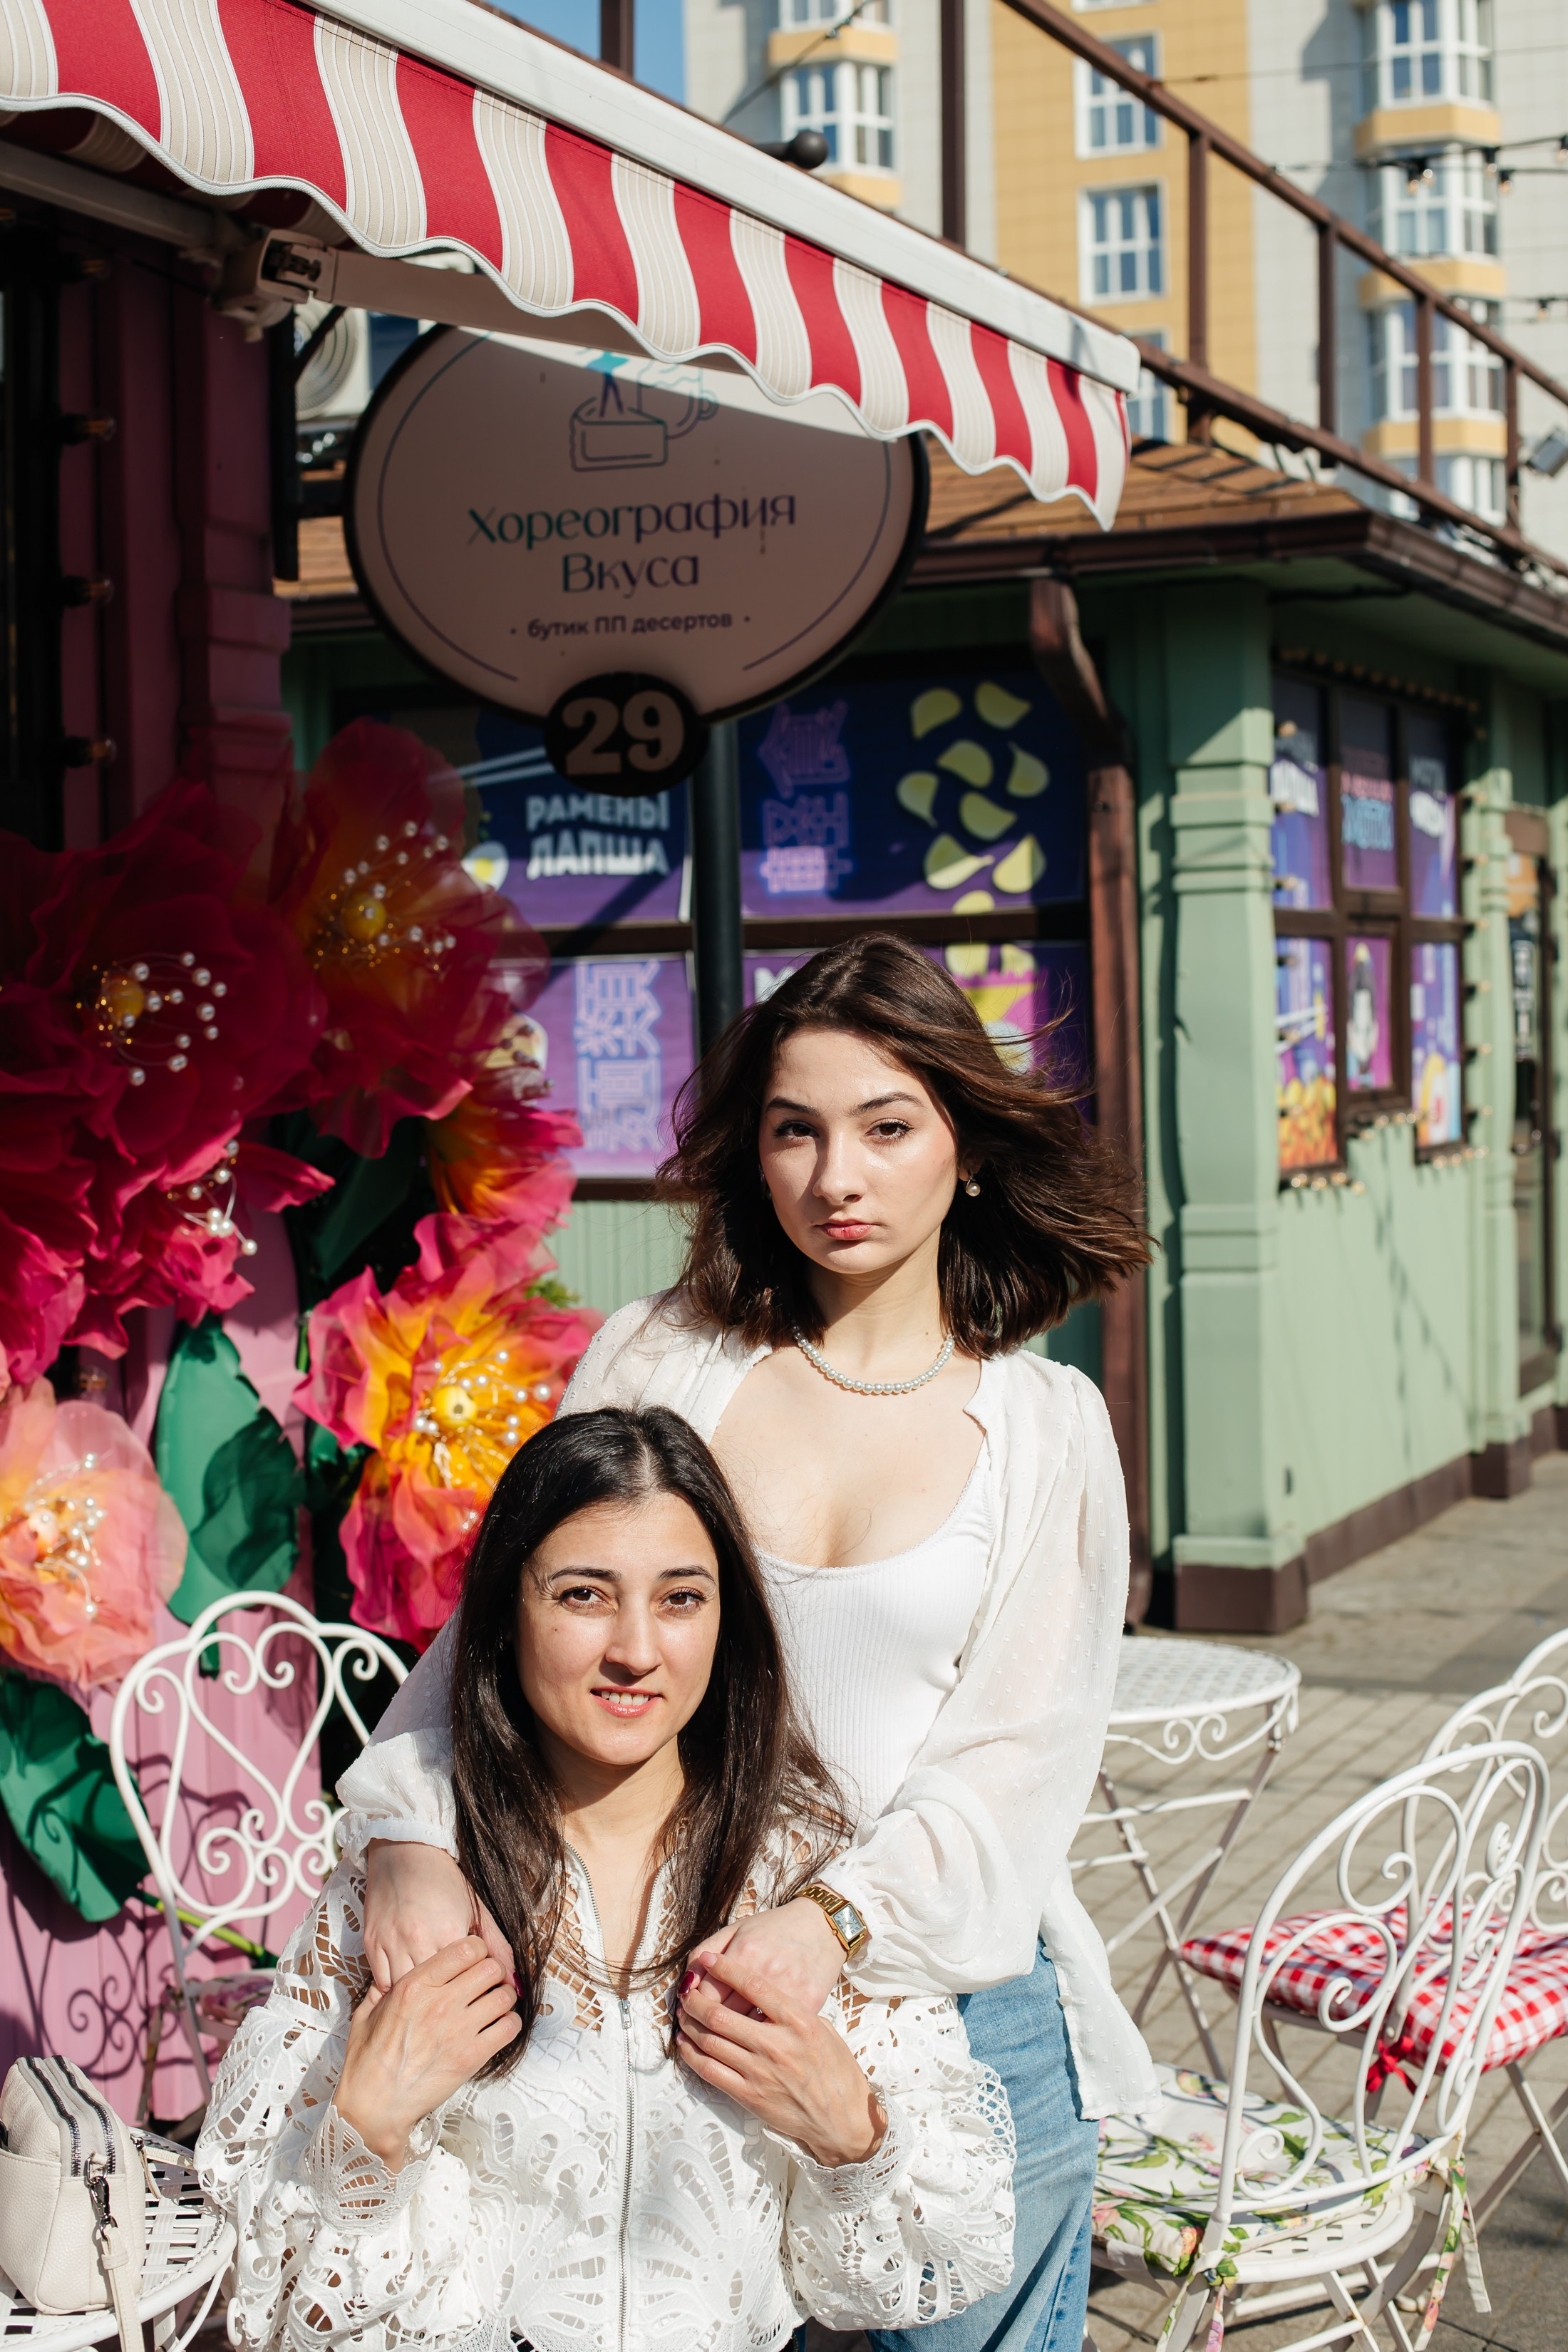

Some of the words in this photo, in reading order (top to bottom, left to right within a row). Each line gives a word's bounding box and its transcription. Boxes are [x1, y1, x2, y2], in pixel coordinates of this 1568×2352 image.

[468, 493, 795, 550] Хореография
[562, 552, 698, 599] Вкуса
[527, 618, 589, 641] бутик
[594, 615, 626, 634] ПП
[632, 613, 732, 634] десертов
[562, 690, 684, 775] 29
[526, 791, 669, 832] РАМЕНЫ
[526, 830, 669, 881] ЛАПША
